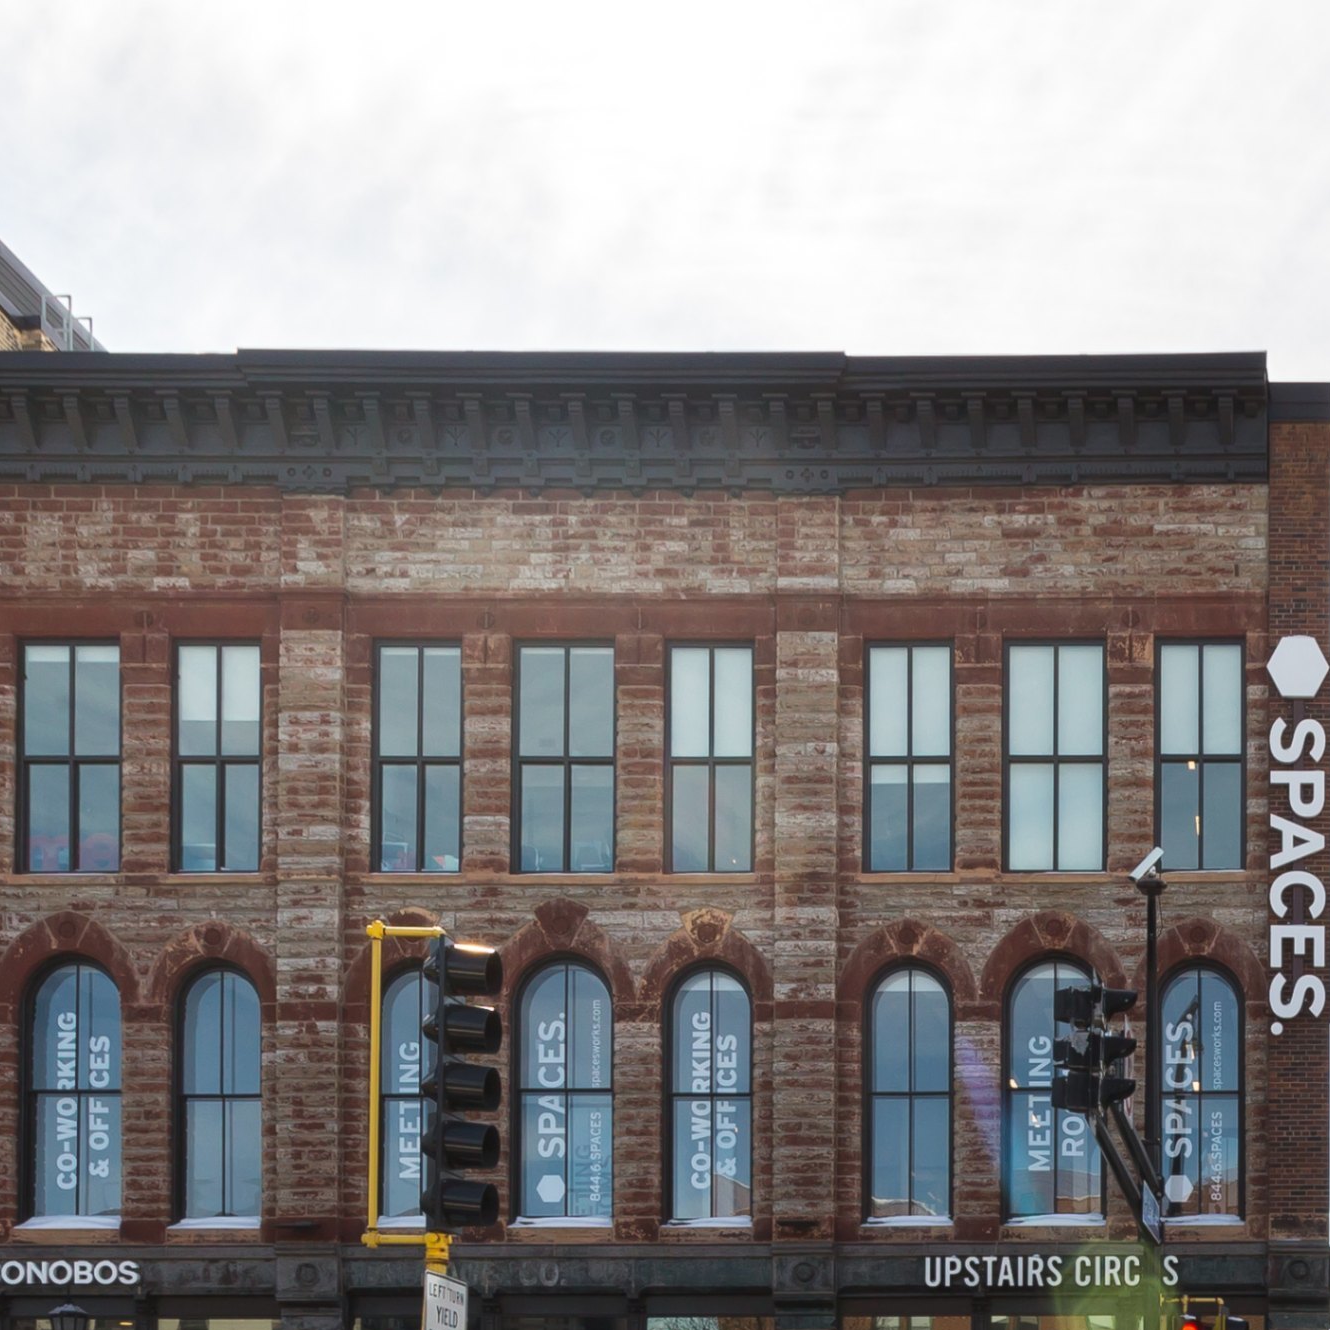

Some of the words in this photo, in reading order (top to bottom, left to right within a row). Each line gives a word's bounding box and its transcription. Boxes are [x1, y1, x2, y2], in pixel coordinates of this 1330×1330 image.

[1268, 716, 1326, 1036] SPACES.
[89, 1035, 111, 1151] OFFCES
[537, 1011, 566, 1159] SPACES.
[591, 999, 601, 1089] spacesworks.com
[716, 1034, 737, 1149] OFFICES
[1165, 1012, 1194, 1159] SPACES.
[1213, 1001, 1223, 1091] spacesworks.com
[57, 1011, 78, 1190] CO-WORKING
[398, 1041, 421, 1180] MEETING
[691, 1011, 711, 1190] CO-WORKING
[1028, 1035, 1052, 1171] MEETING
[88, 1157, 110, 1178] &
[589, 1111, 602, 1202] 844.6.SPACES
[716, 1156, 737, 1178] &
[1210, 1110, 1223, 1202] 844.6.SPACES
[429, 1281, 446, 1300] LEFT
[446, 1287, 464, 1306] TURN
[436, 1305, 459, 1329] YIELD
[924, 1255, 1063, 1288] UPSTAIRS
[1074, 1254, 1180, 1288] CIRCS
